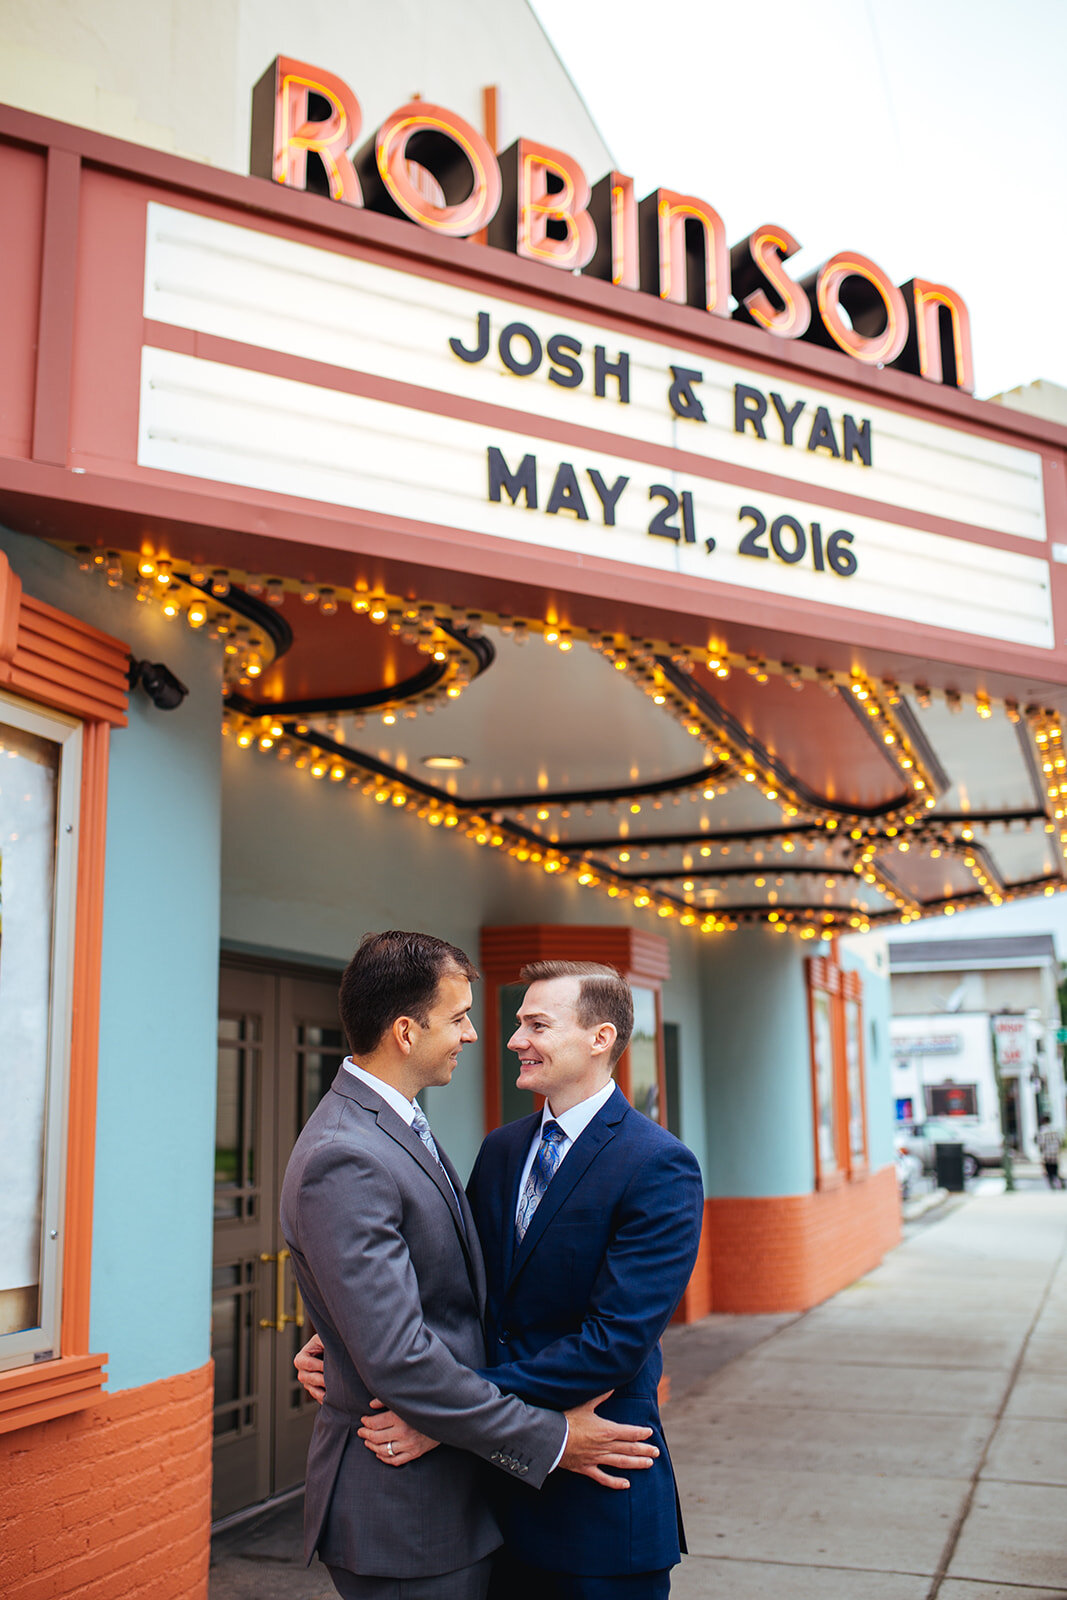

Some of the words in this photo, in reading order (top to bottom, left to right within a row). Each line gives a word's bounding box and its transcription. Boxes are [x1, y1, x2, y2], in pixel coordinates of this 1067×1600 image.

[449, 312, 630, 404] JOSH
[668, 365, 707, 423] &
[734, 383, 873, 467] RYAN
[487, 446, 630, 526] MAY
[648, 485, 717, 553] 21,
[738, 506, 859, 577] 2016
